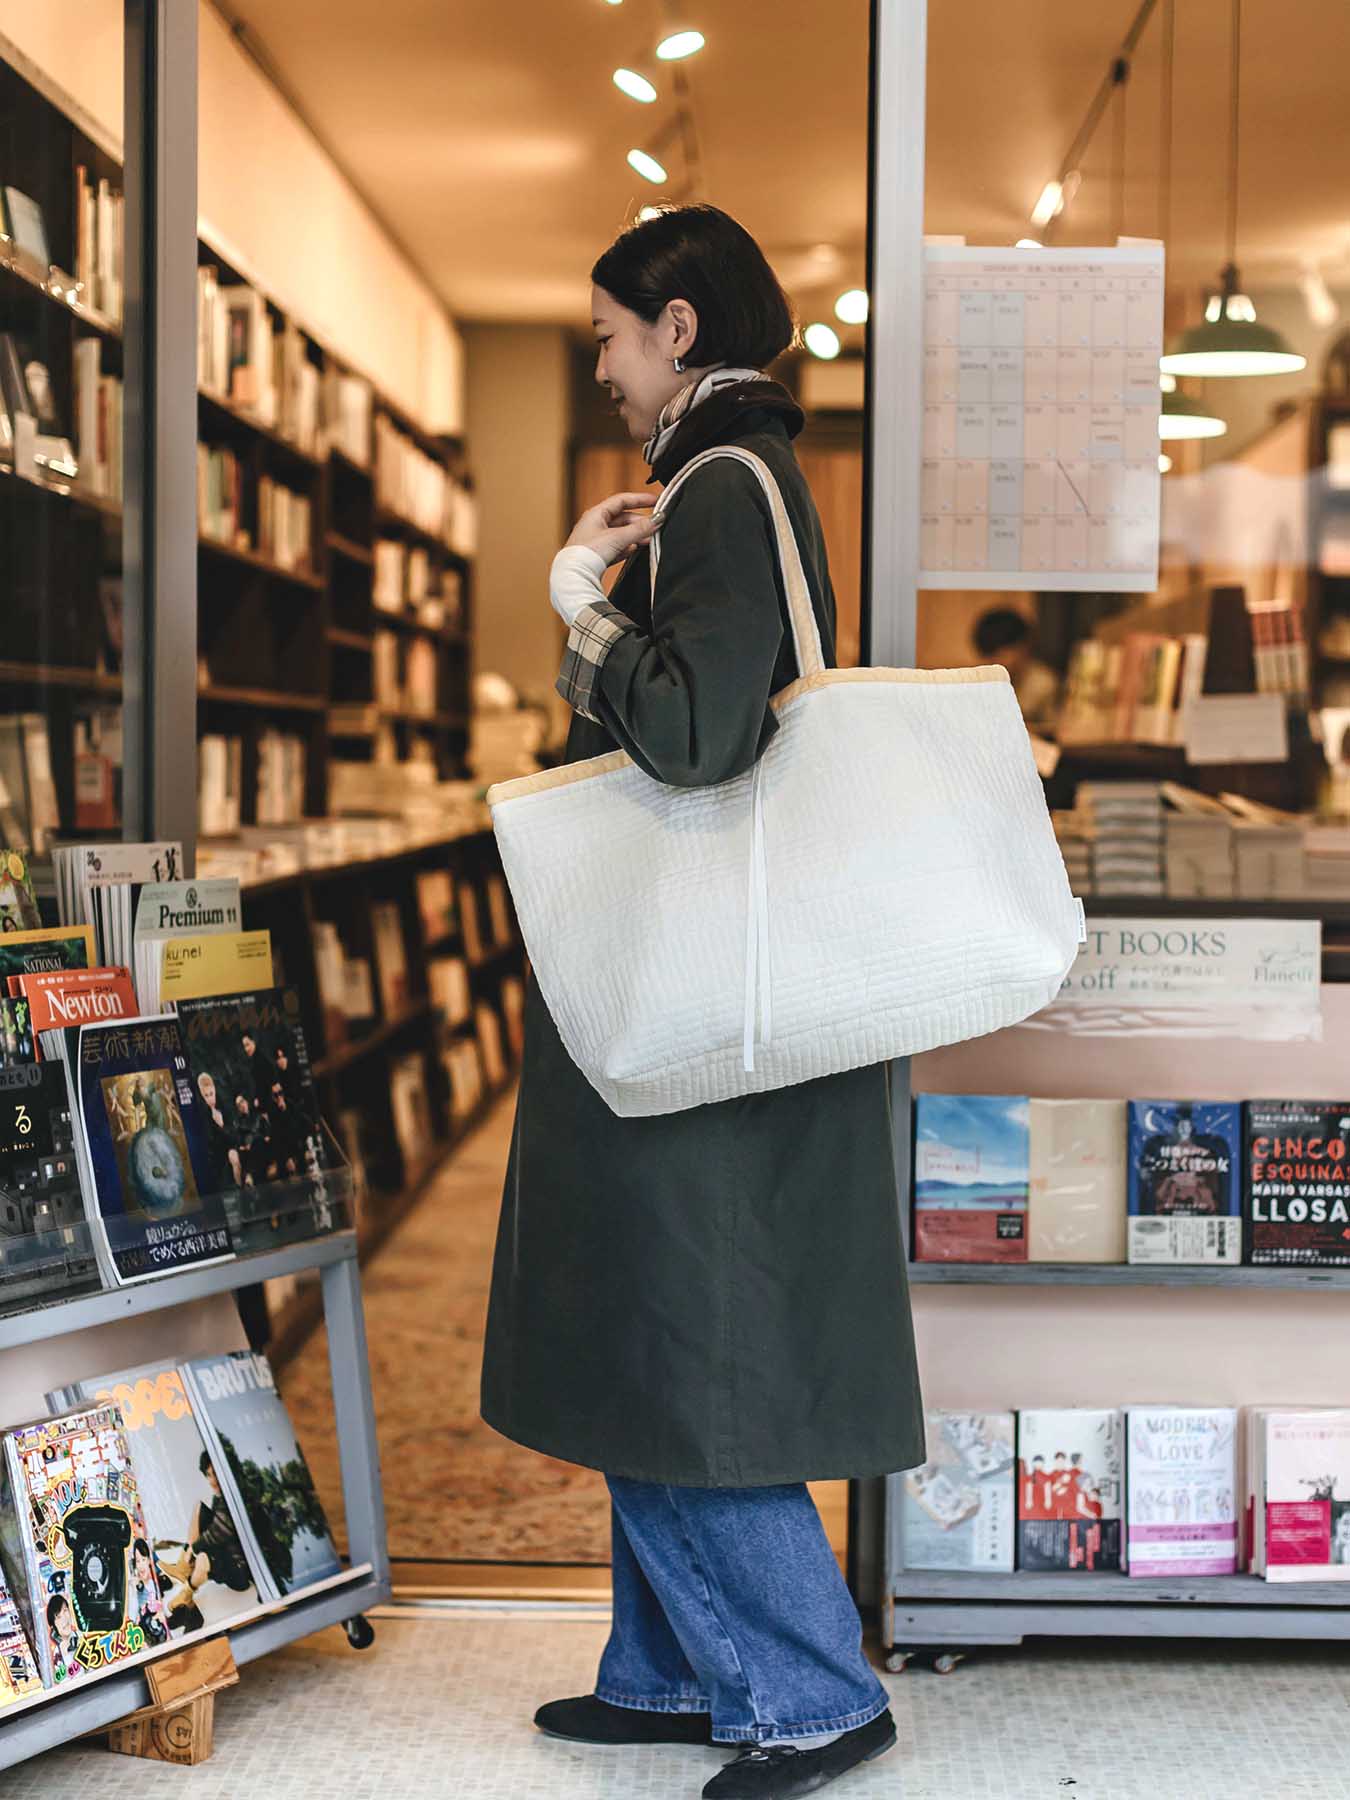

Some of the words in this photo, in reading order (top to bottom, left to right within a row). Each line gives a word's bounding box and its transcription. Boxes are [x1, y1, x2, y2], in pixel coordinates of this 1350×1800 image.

[158, 903, 224, 929] Premium
[226, 906, 237, 922] 11
[1119, 930, 1226, 956] BOOKS
[24, 957, 64, 973] NATIONAL
[1081, 963, 1120, 990] off
[45, 987, 124, 1022] Newton
[174, 1055, 187, 1071] 10
[15, 1104, 32, 1134] る
[1252, 1136, 1346, 1161] CINCO
[1252, 1184, 1296, 1197] MARIO
[1298, 1184, 1350, 1198] VARGAS
[1252, 1198, 1349, 1223] LLOSA
[196, 1353, 275, 1401] BRUTUS
[1146, 1416, 1219, 1434] MODERN
[1158, 1444, 1204, 1460] LOVE
[53, 1477, 82, 1517] 100
[74, 1622, 145, 1670] くろでんわ
